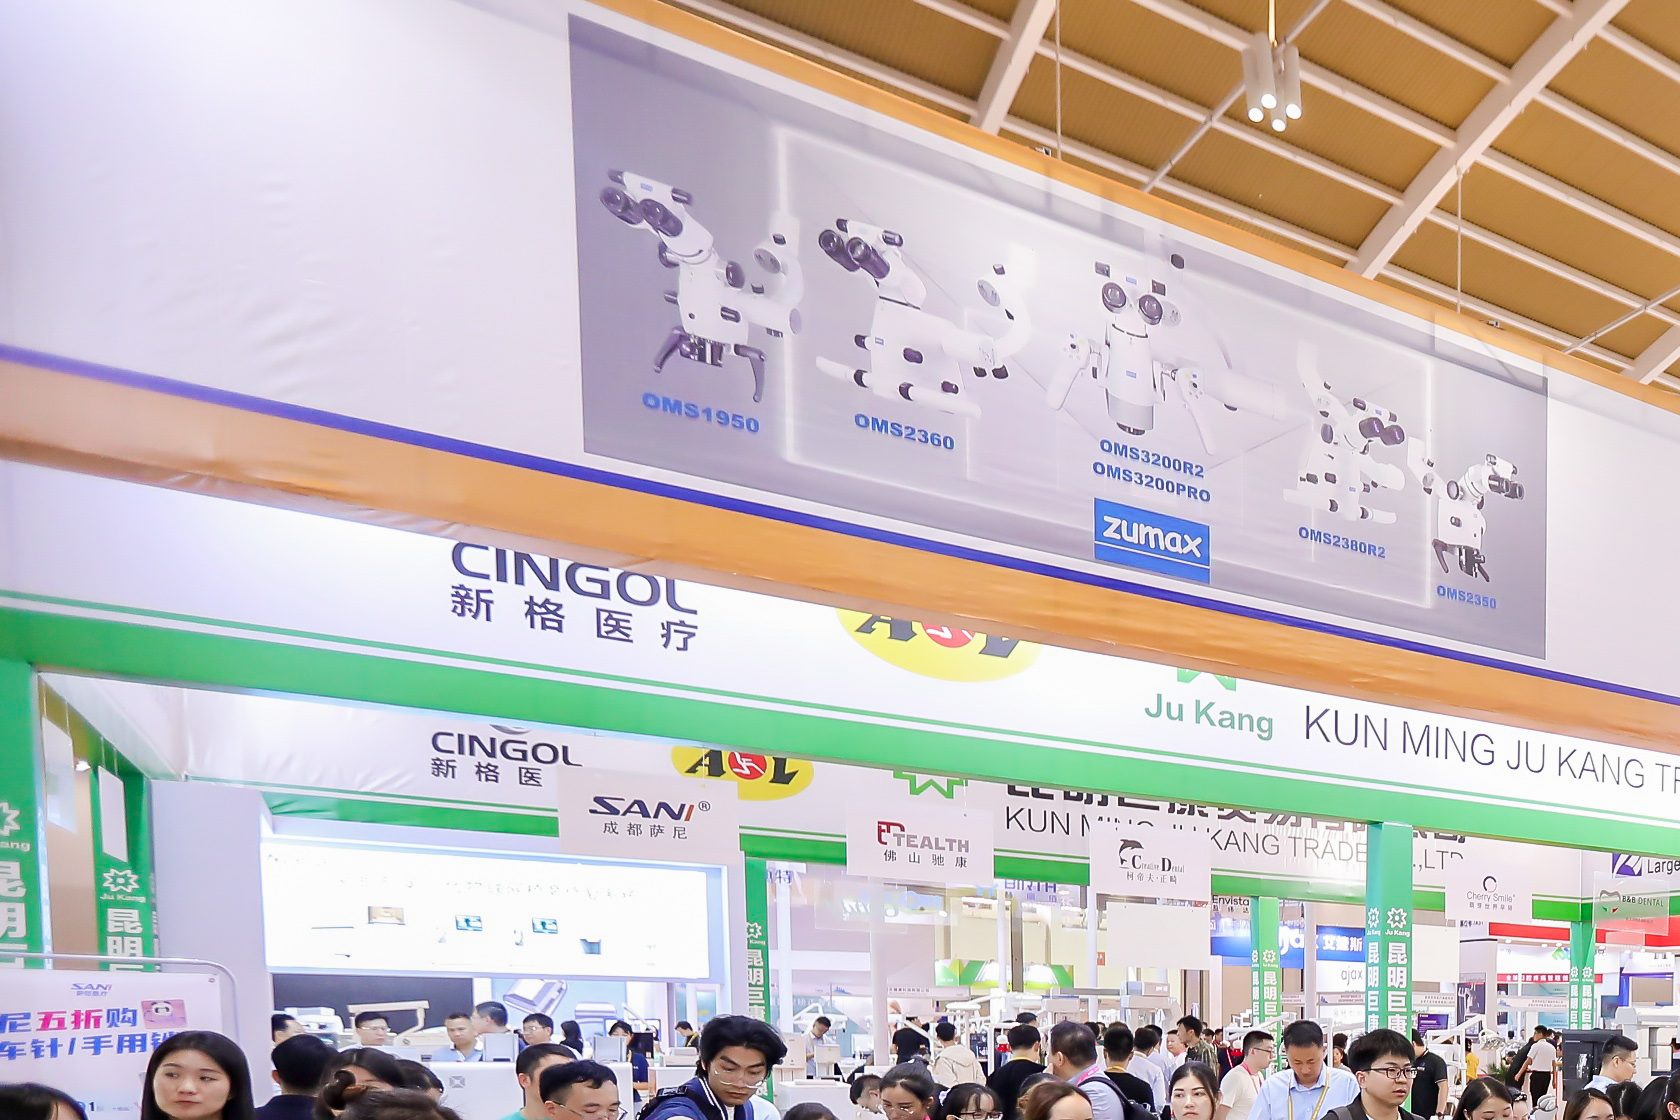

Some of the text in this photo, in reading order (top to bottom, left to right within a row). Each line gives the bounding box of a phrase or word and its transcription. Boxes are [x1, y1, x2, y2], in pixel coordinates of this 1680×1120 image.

[641, 392, 760, 434] OMS1950
[854, 412, 955, 451] OMS2360
[1099, 438, 1205, 479] OMS3200R2
[1092, 461, 1211, 503] OMS3200PRO
[1102, 513, 1203, 558] zumax
[1298, 526, 1386, 559] OMS2380R2
[452, 541, 698, 615] CINGOL
[450, 584, 698, 652] 新格医疗
[1144, 693, 1273, 742] Ju Kang
[431, 730, 583, 768] CINGOL
[1304, 704, 1388, 751] KUN
[1402, 721, 1495, 766] MING
[1506, 739, 1546, 774] JU
[1557, 746, 1645, 789] KANG
[602, 821, 689, 840] 成都萨尼
[1006, 805, 1070, 836] KUN
[883, 848, 968, 870] 佛山驰康
[1211, 895, 1250, 907] Envista
[1466, 890, 1493, 905] Cherry
[1622, 895, 1664, 907] B&B DENTAL
